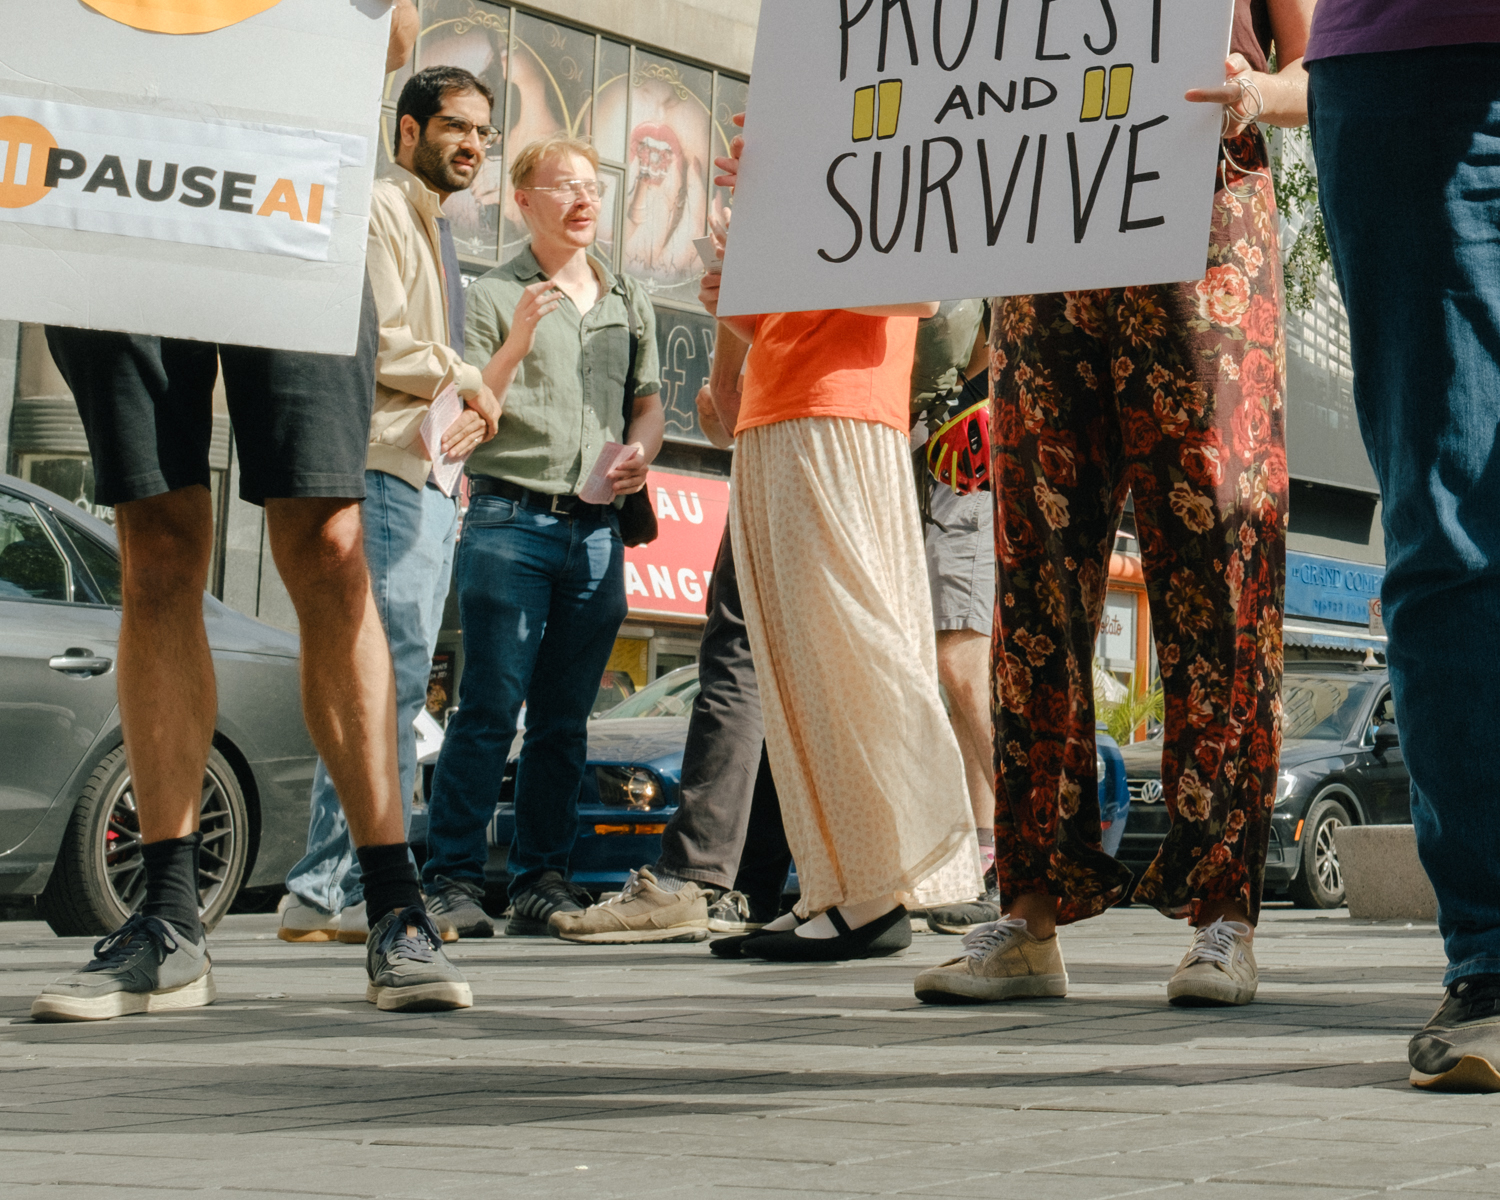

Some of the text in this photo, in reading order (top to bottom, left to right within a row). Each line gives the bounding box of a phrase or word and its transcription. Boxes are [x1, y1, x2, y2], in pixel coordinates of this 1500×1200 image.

[934, 77, 1057, 124] AND
[817, 115, 1169, 263] SURVIVE
[1300, 563, 1341, 588] GRAND
